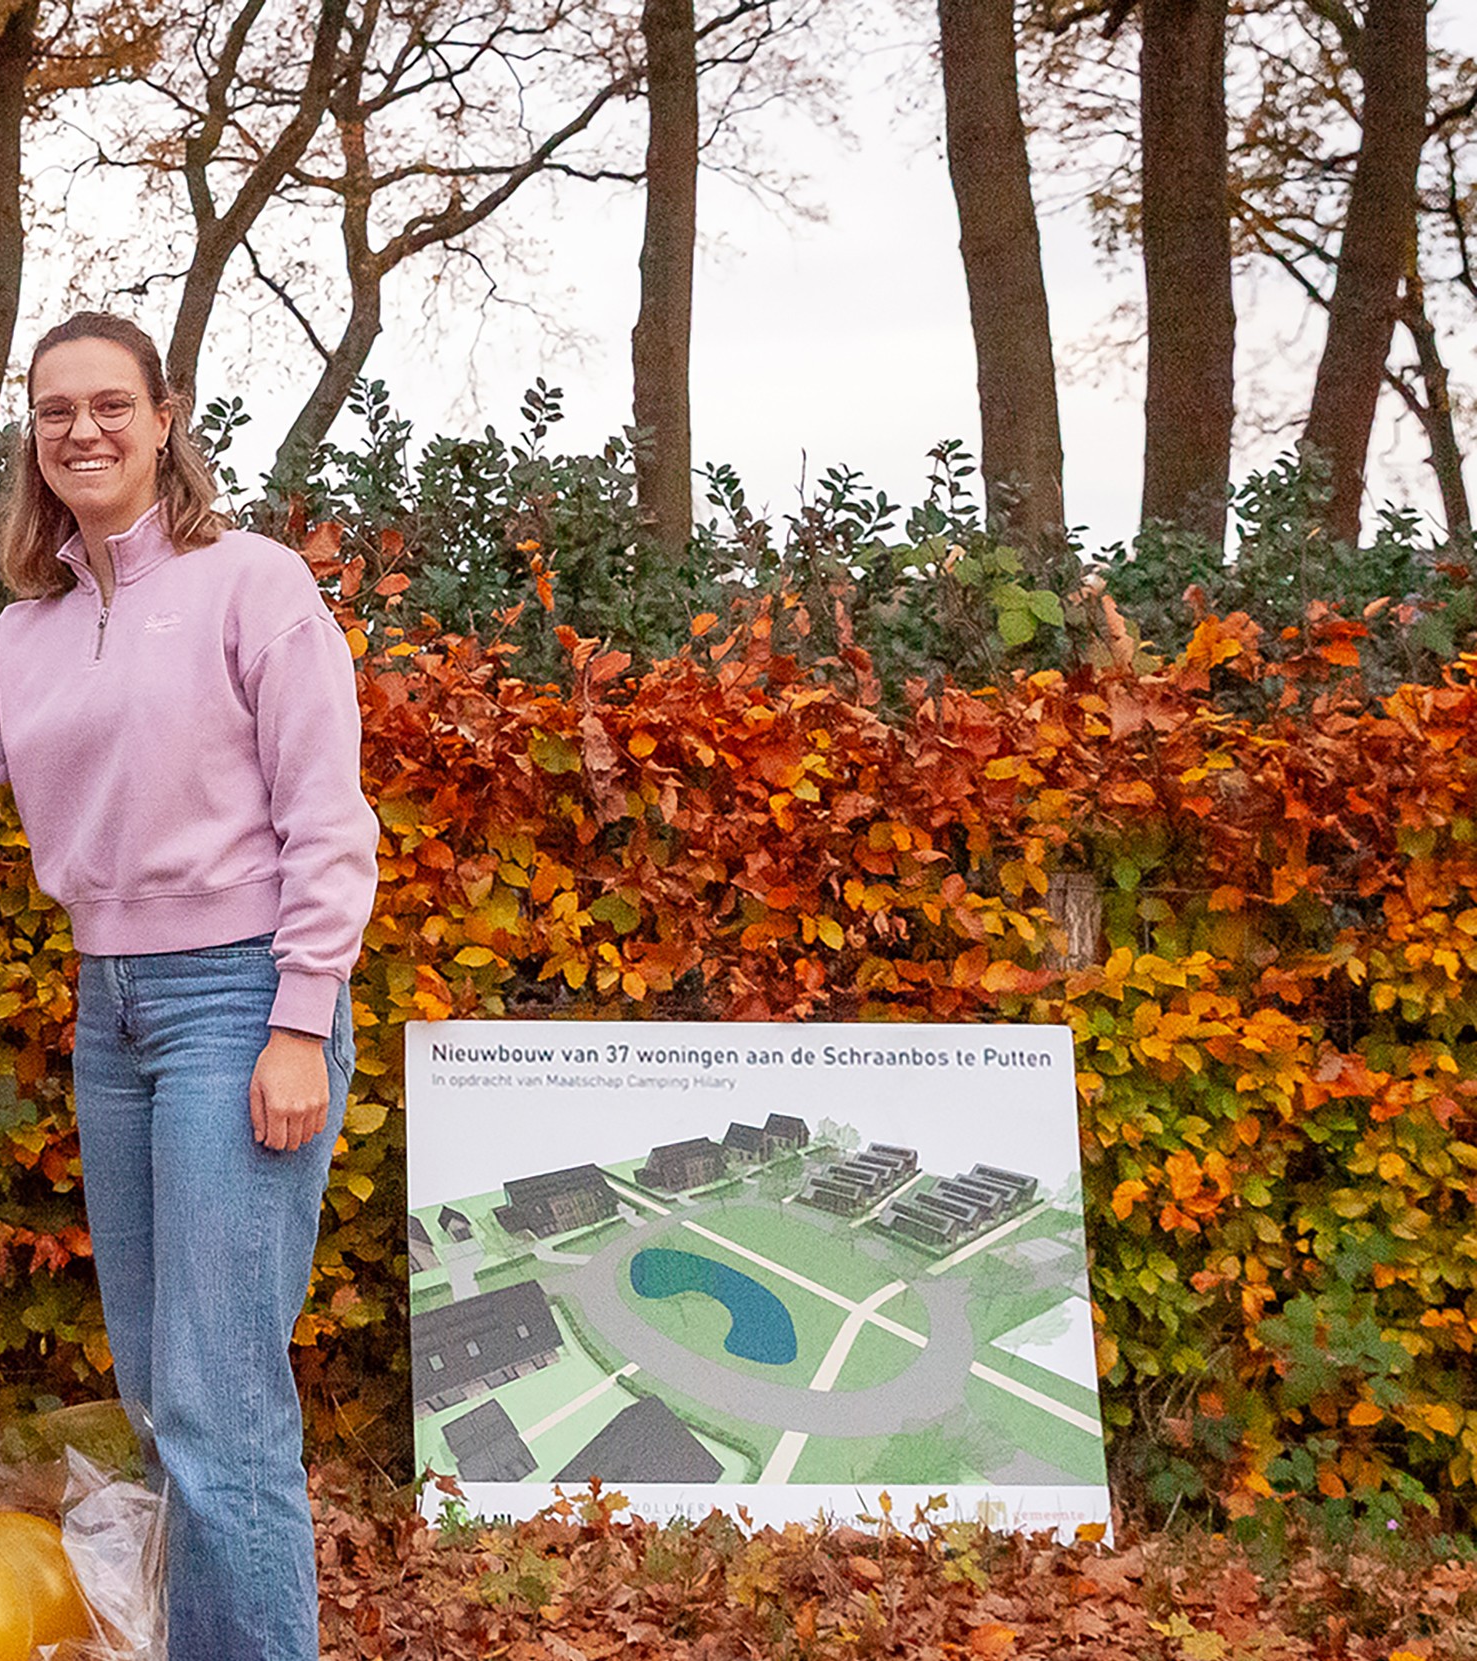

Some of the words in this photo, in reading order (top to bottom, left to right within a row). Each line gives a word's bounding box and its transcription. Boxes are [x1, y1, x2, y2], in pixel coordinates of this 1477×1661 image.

[432, 1044, 554, 1063] Nieuwbouw
[562, 1049, 599, 1063] van
[606, 1045, 629, 1063] 37
[637, 1046, 739, 1069] woningen
[746, 1050, 784, 1065] aan
[791, 1047, 815, 1065] de
[824, 1046, 949, 1066] Schraanbos
[957, 1050, 975, 1066] te
[984, 1048, 1052, 1067] Putten
[432, 1074, 445, 1086] In
[449, 1074, 512, 1088] opdracht
[517, 1077, 543, 1086] van
[546, 1074, 623, 1088] Maatschap
[627, 1074, 689, 1089] Camping
[694, 1075, 737, 1089] Hilary
